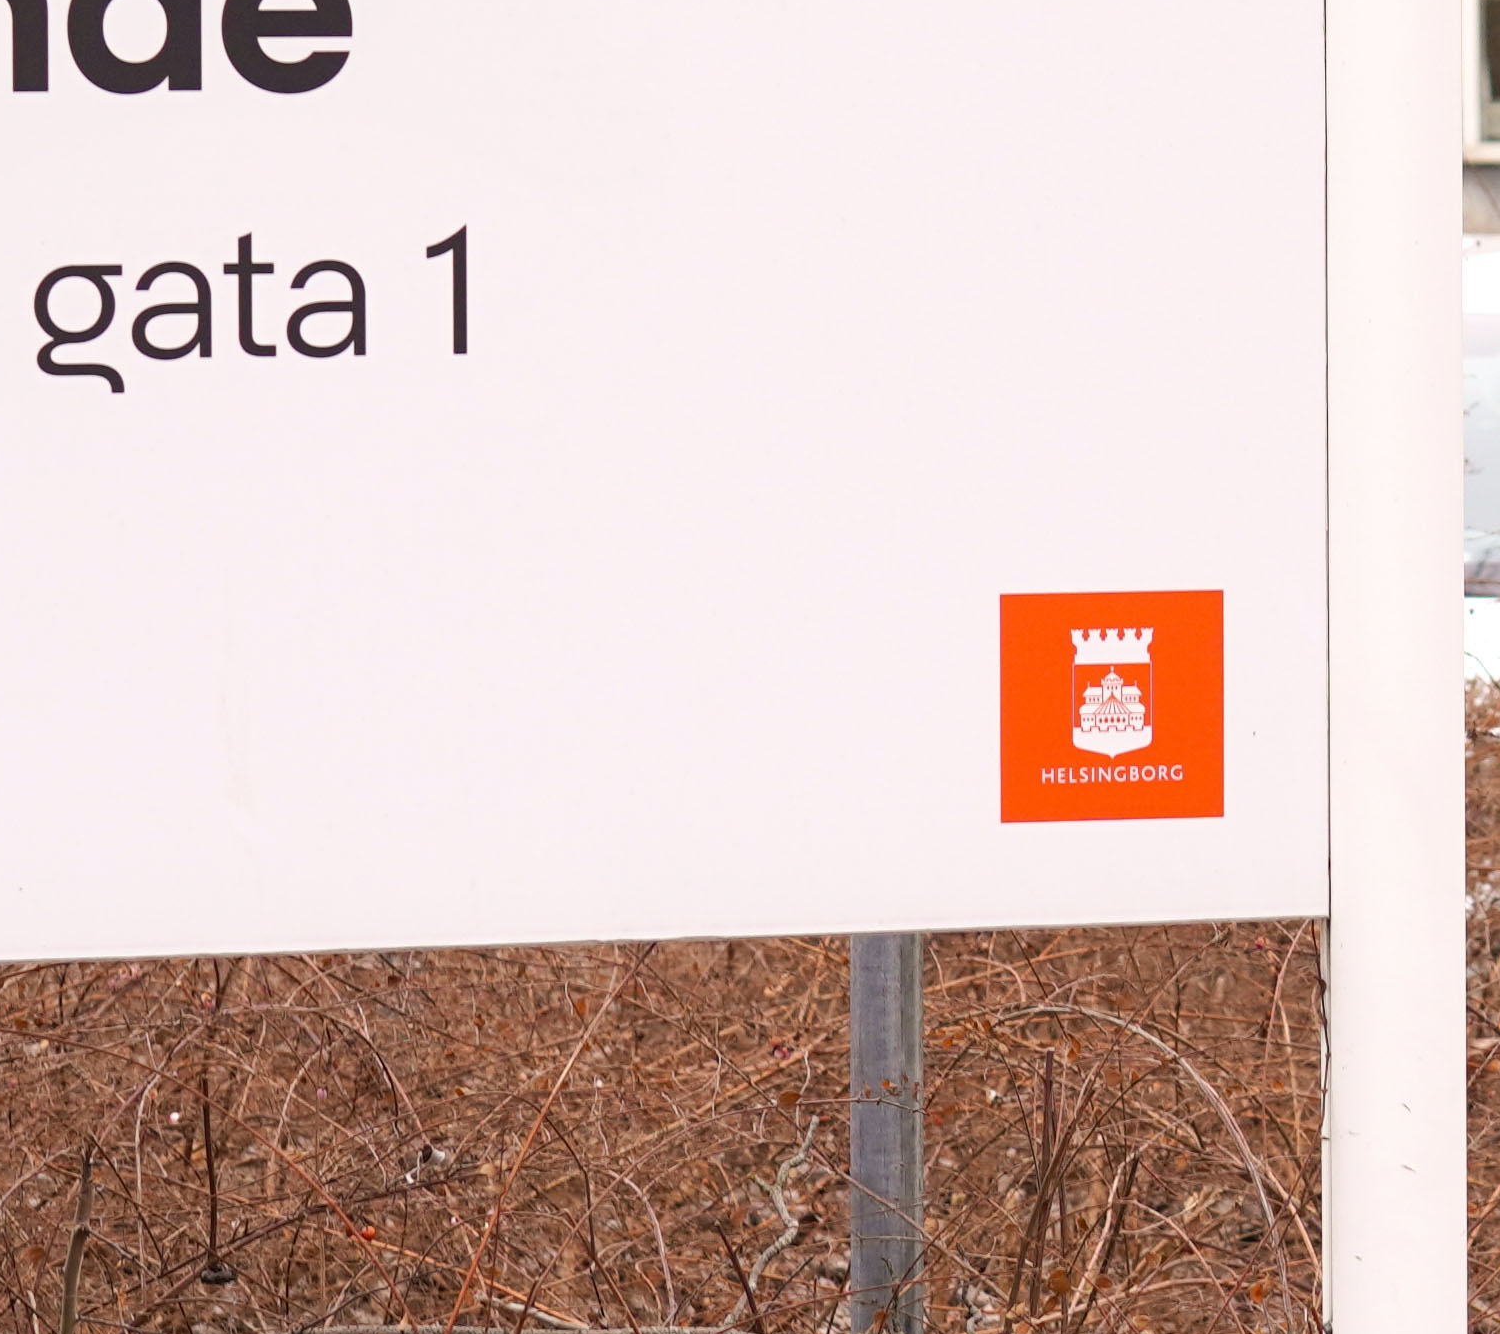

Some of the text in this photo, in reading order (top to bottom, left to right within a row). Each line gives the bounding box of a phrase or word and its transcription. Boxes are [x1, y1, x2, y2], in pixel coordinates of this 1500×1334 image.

[32, 231, 368, 395] gata
[425, 223, 473, 356] 1
[1041, 764, 1184, 784] HELSINGBORG
